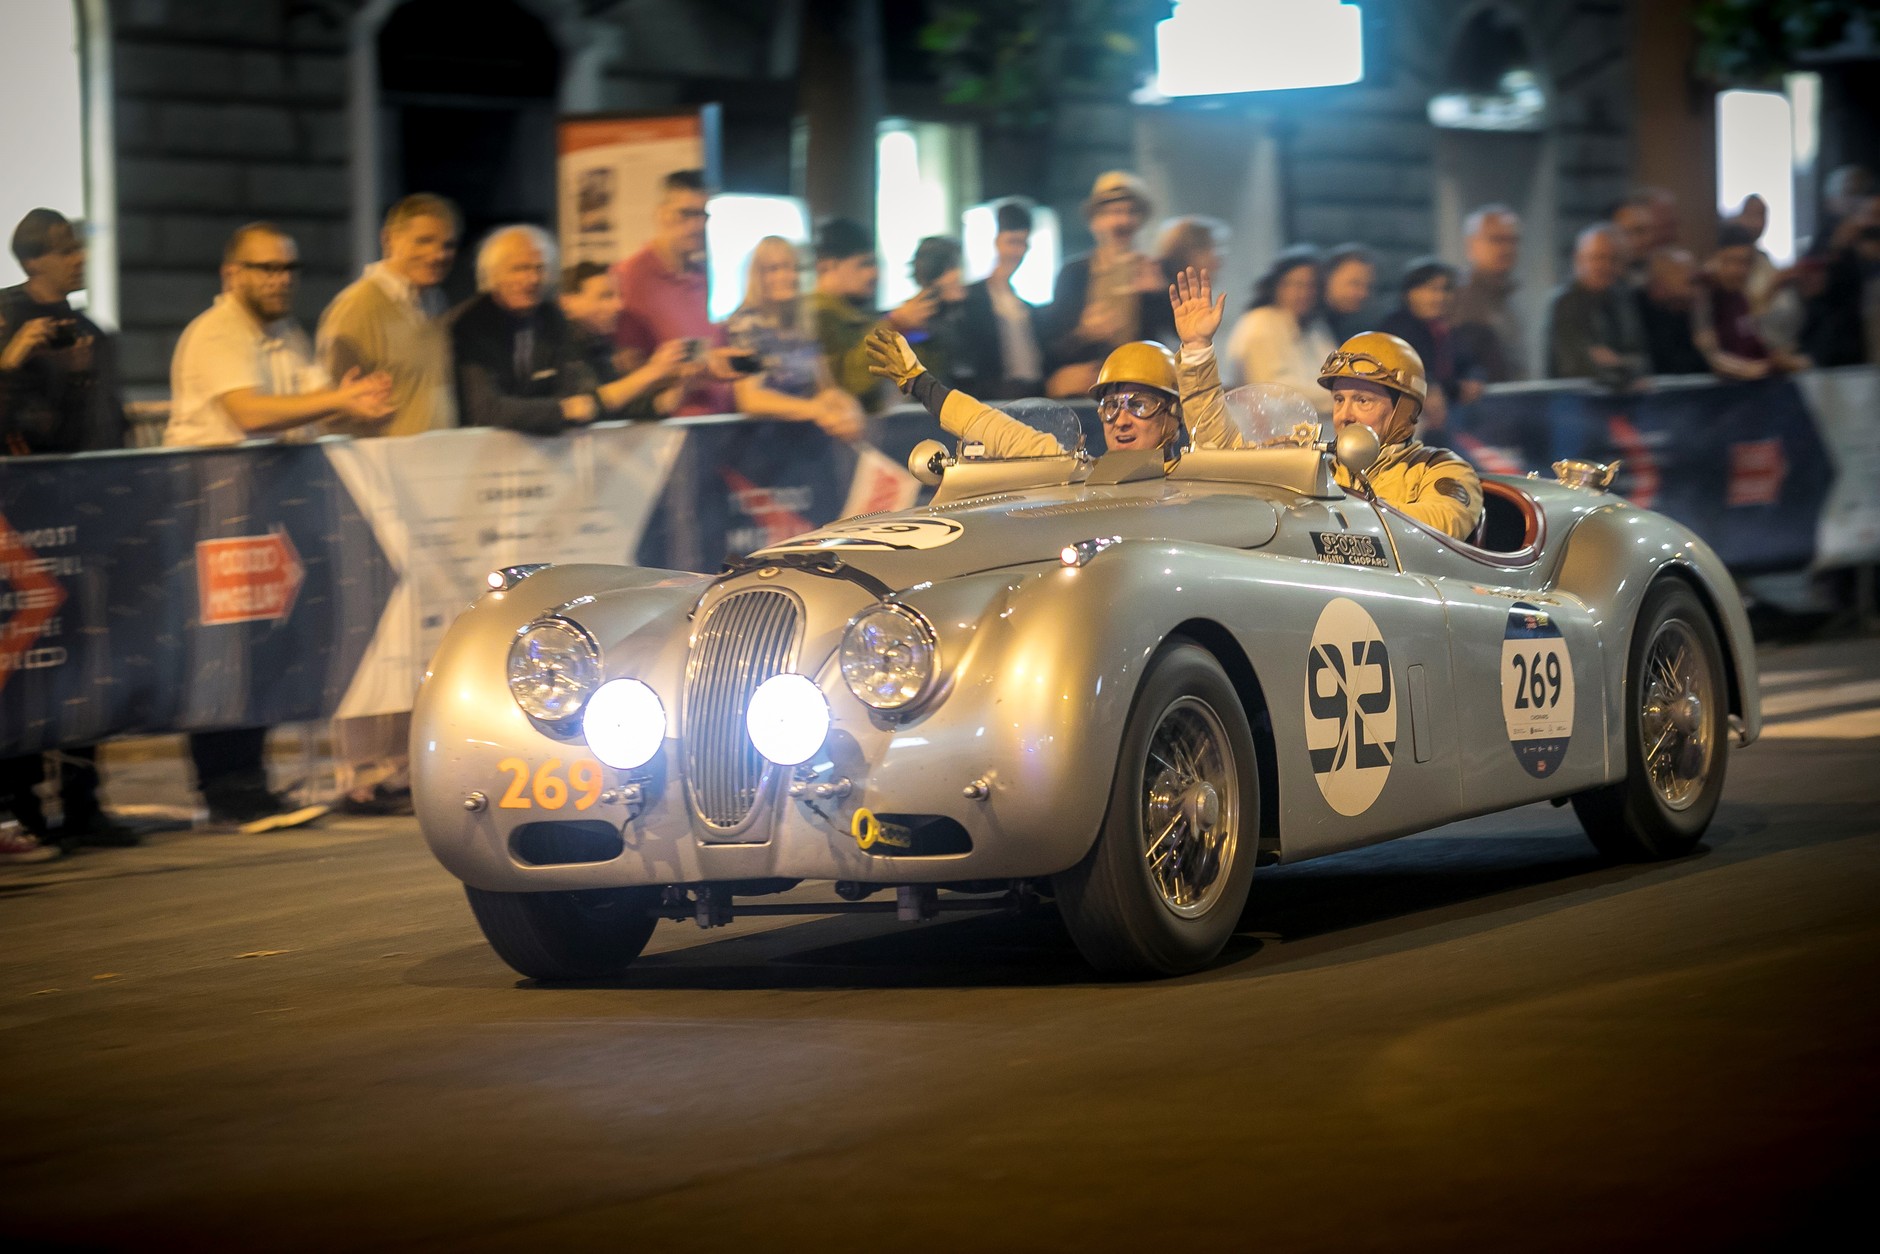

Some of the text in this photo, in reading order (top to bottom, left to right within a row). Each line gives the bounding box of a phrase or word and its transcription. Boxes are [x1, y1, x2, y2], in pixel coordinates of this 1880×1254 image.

[1320, 532, 1376, 558] SPORTS
[1348, 555, 1388, 567] CHOPARD
[1308, 640, 1396, 774] 92
[1512, 651, 1562, 709] 269
[496, 757, 604, 811] 269
